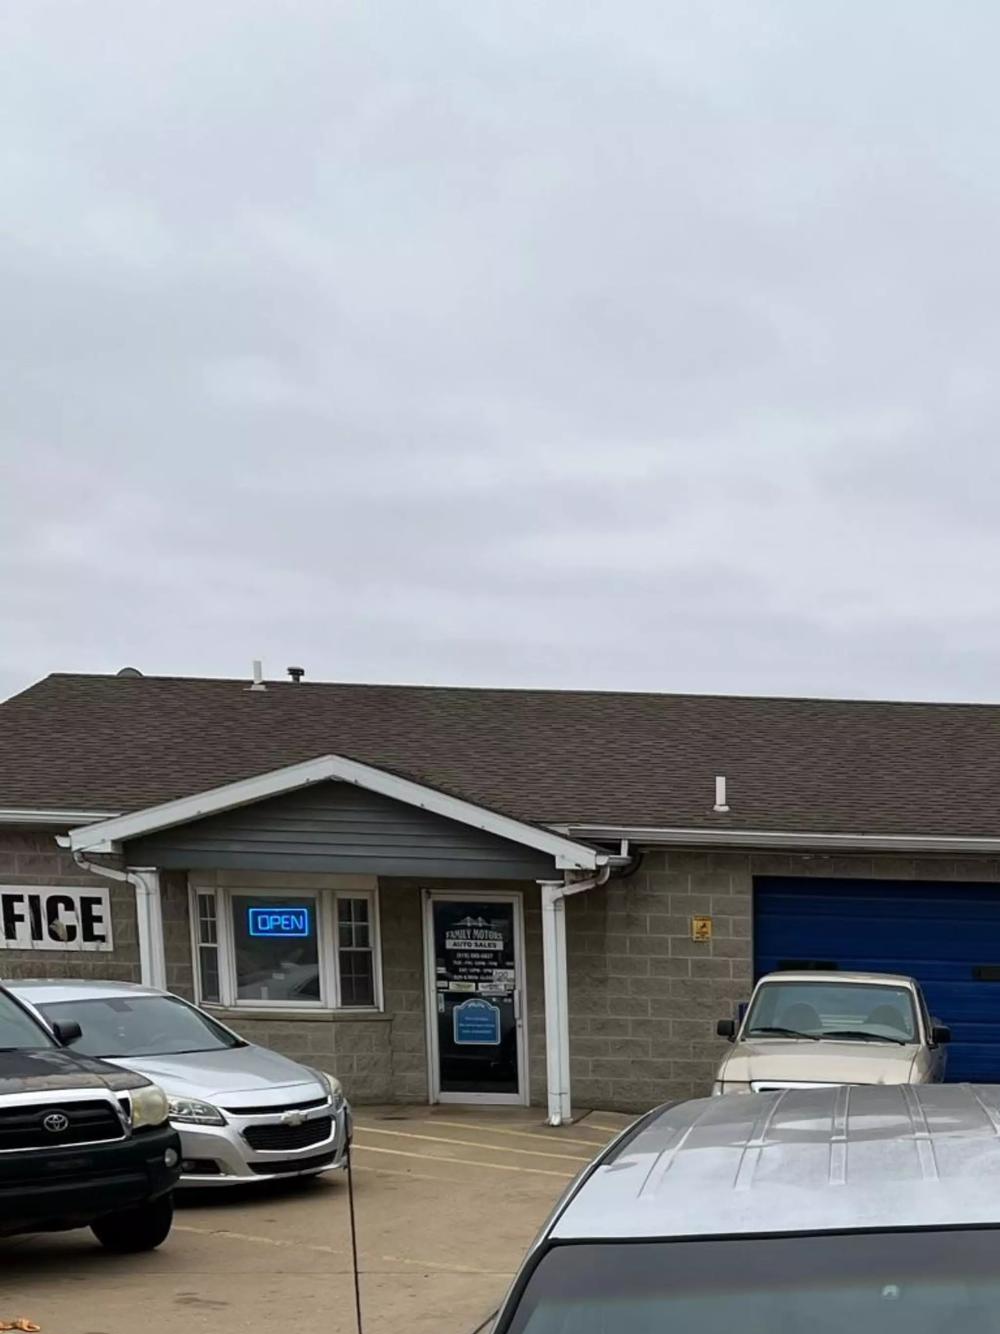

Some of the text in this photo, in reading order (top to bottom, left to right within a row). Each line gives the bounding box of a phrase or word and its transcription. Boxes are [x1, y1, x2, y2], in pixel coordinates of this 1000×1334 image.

[257, 914, 303, 930] OPEN
[445, 928, 472, 939] FAMILY
[474, 941, 497, 949] SALES
